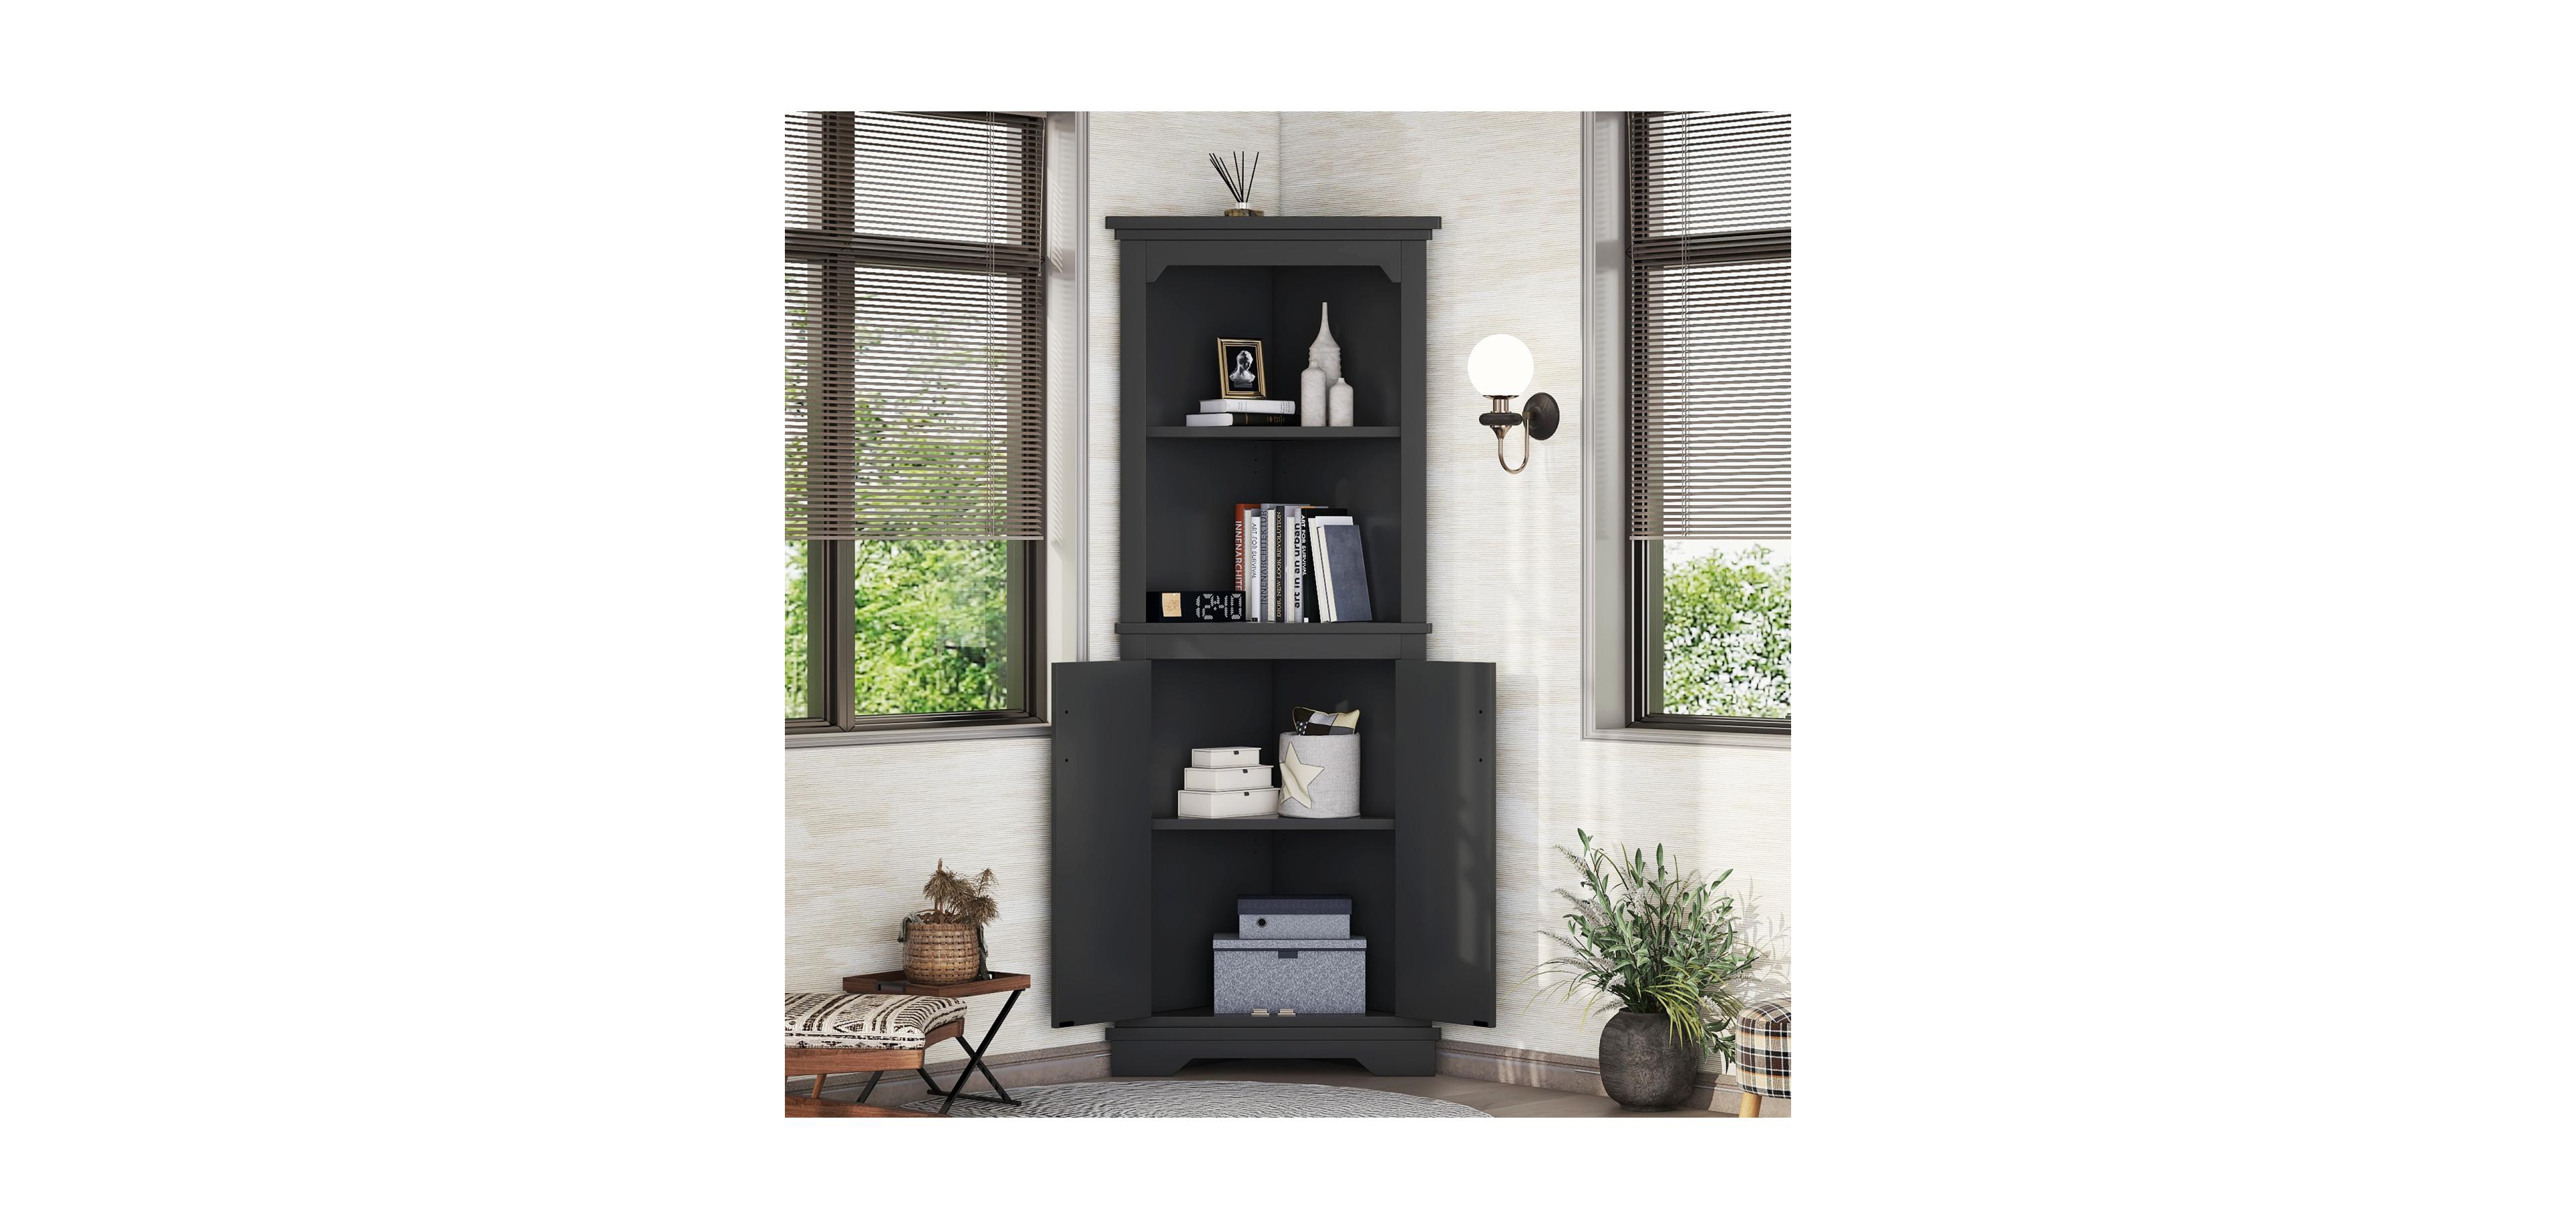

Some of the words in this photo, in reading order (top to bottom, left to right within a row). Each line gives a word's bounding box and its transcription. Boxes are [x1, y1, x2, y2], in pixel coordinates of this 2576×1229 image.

[1294, 560, 1300, 574] an
[1294, 577, 1300, 588] in
[1195, 593, 1242, 620] 12:40
